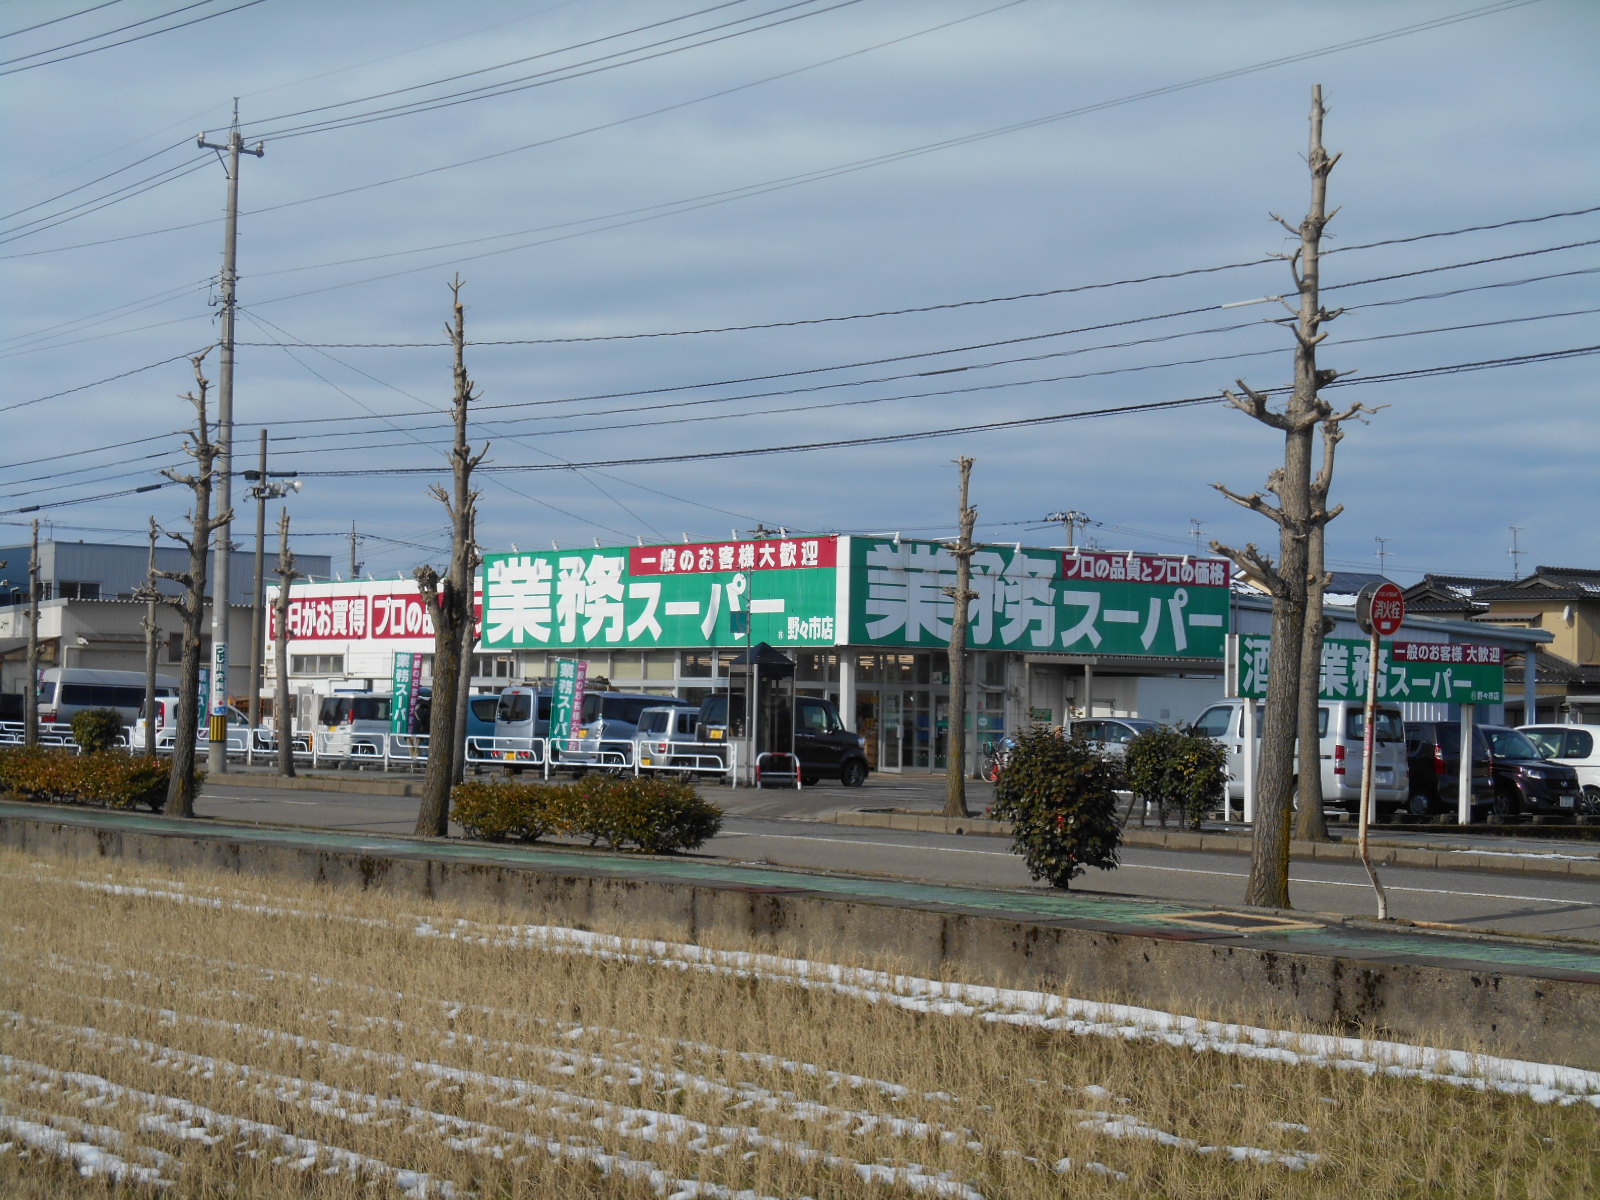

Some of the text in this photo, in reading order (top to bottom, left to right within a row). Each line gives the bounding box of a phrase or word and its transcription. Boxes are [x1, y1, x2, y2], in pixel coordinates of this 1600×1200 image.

[641, 541, 818, 572] 一般のお客様大歓迎
[1066, 554, 1224, 585] プロの品質とプロの価格
[487, 555, 785, 643] 業務スーパー
[865, 544, 1222, 651] 業務スーパー
[1375, 600, 1400, 619] 消火栓
[272, 601, 365, 636] 日がお買得
[787, 616, 833, 640] 野々市店
